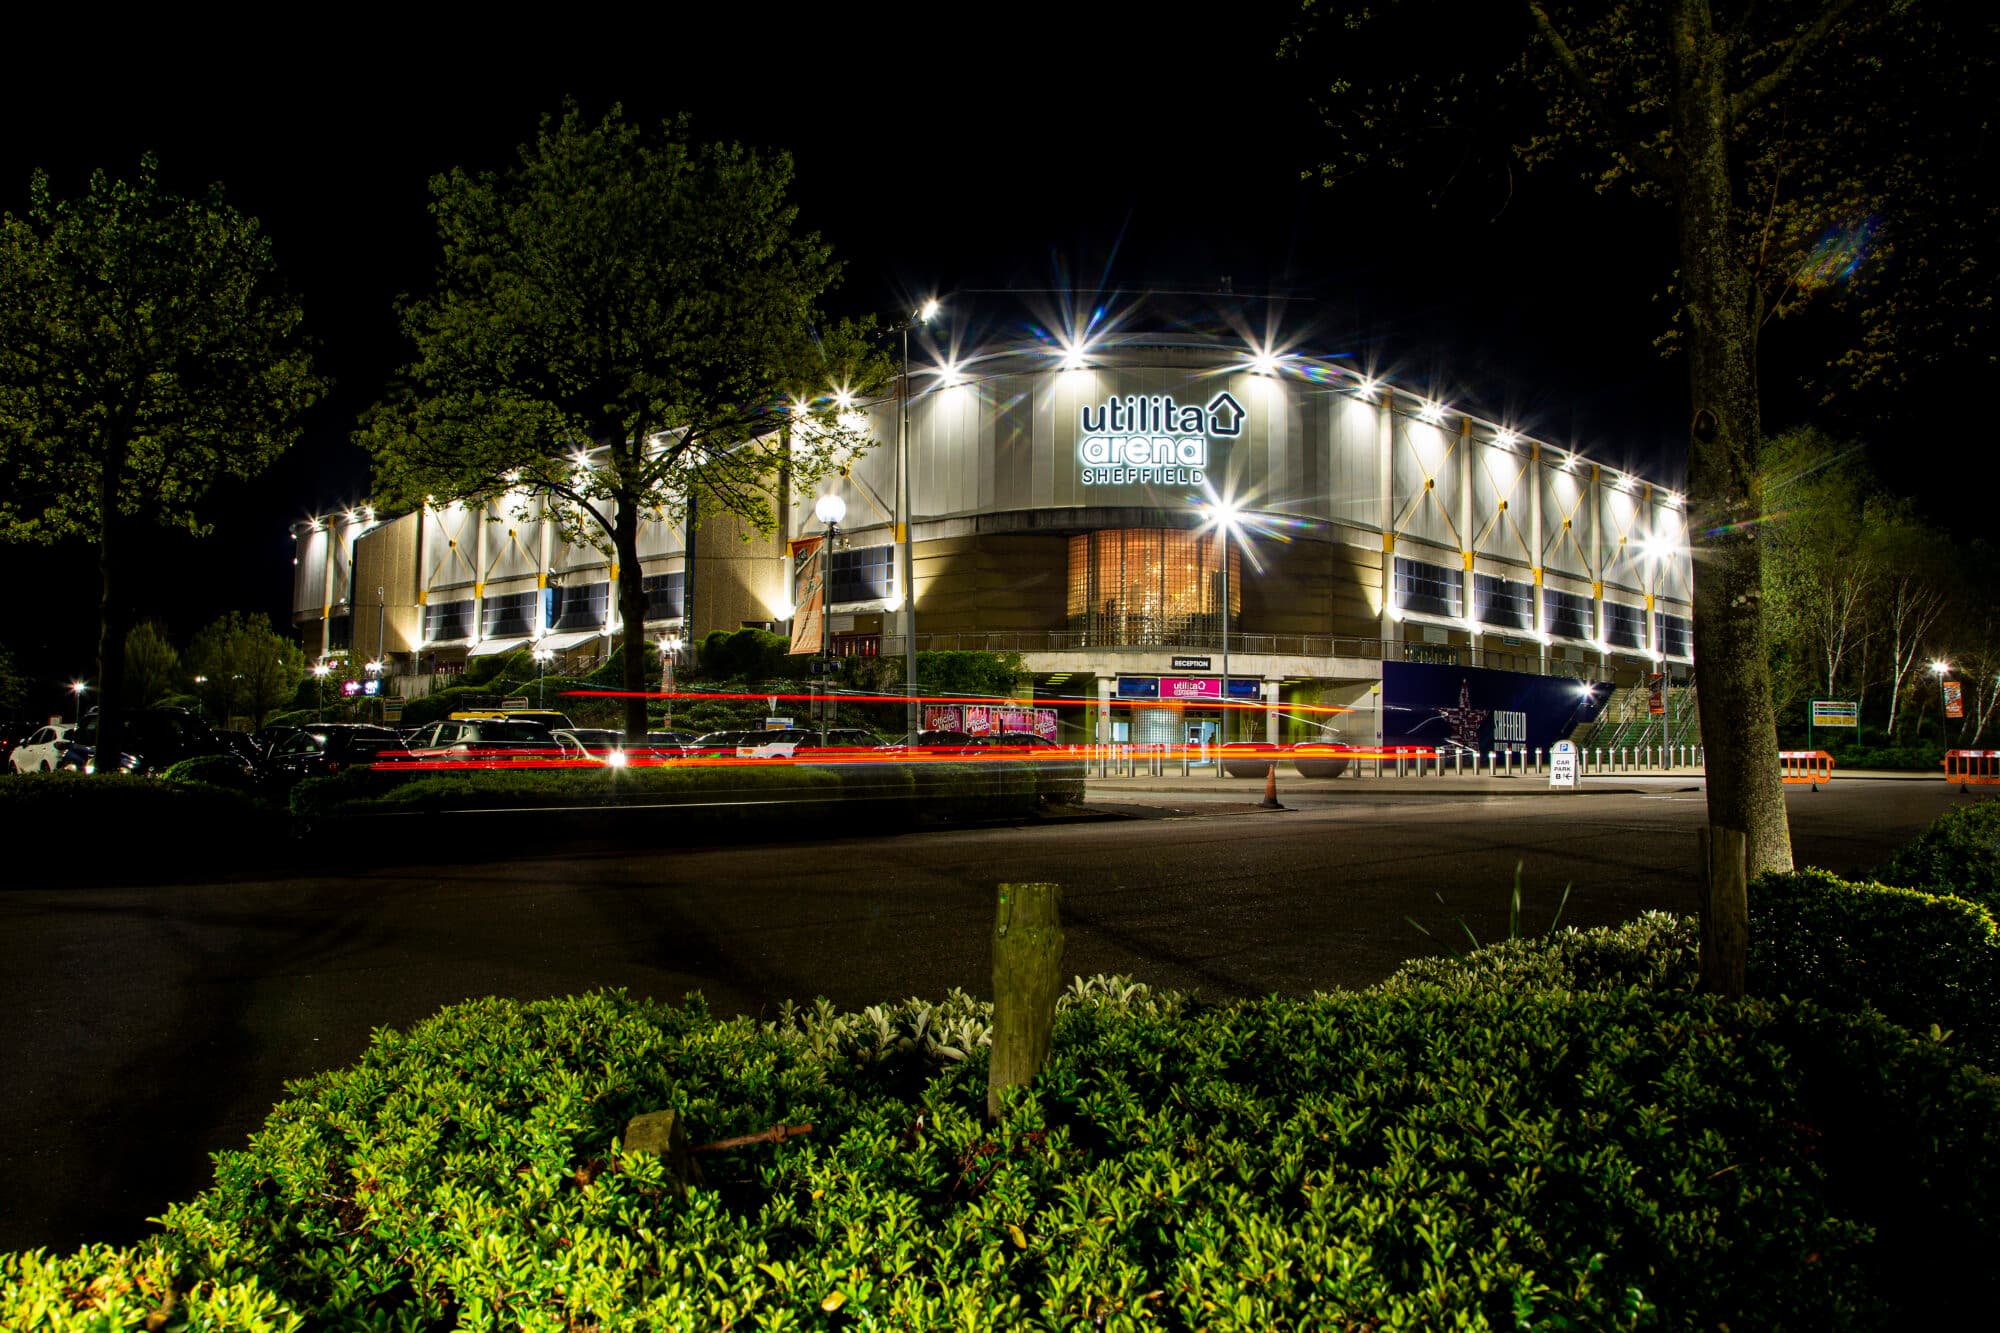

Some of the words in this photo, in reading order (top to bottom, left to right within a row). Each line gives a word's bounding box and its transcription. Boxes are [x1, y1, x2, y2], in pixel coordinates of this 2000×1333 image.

[1083, 396, 1203, 433] utilita
[1082, 435, 1204, 465] arena
[1083, 468, 1203, 484] SHEFFIELD
[1173, 681, 1198, 690] utilita
[932, 711, 955, 727] Official
[1493, 710, 1527, 741] SHEFFIELD
